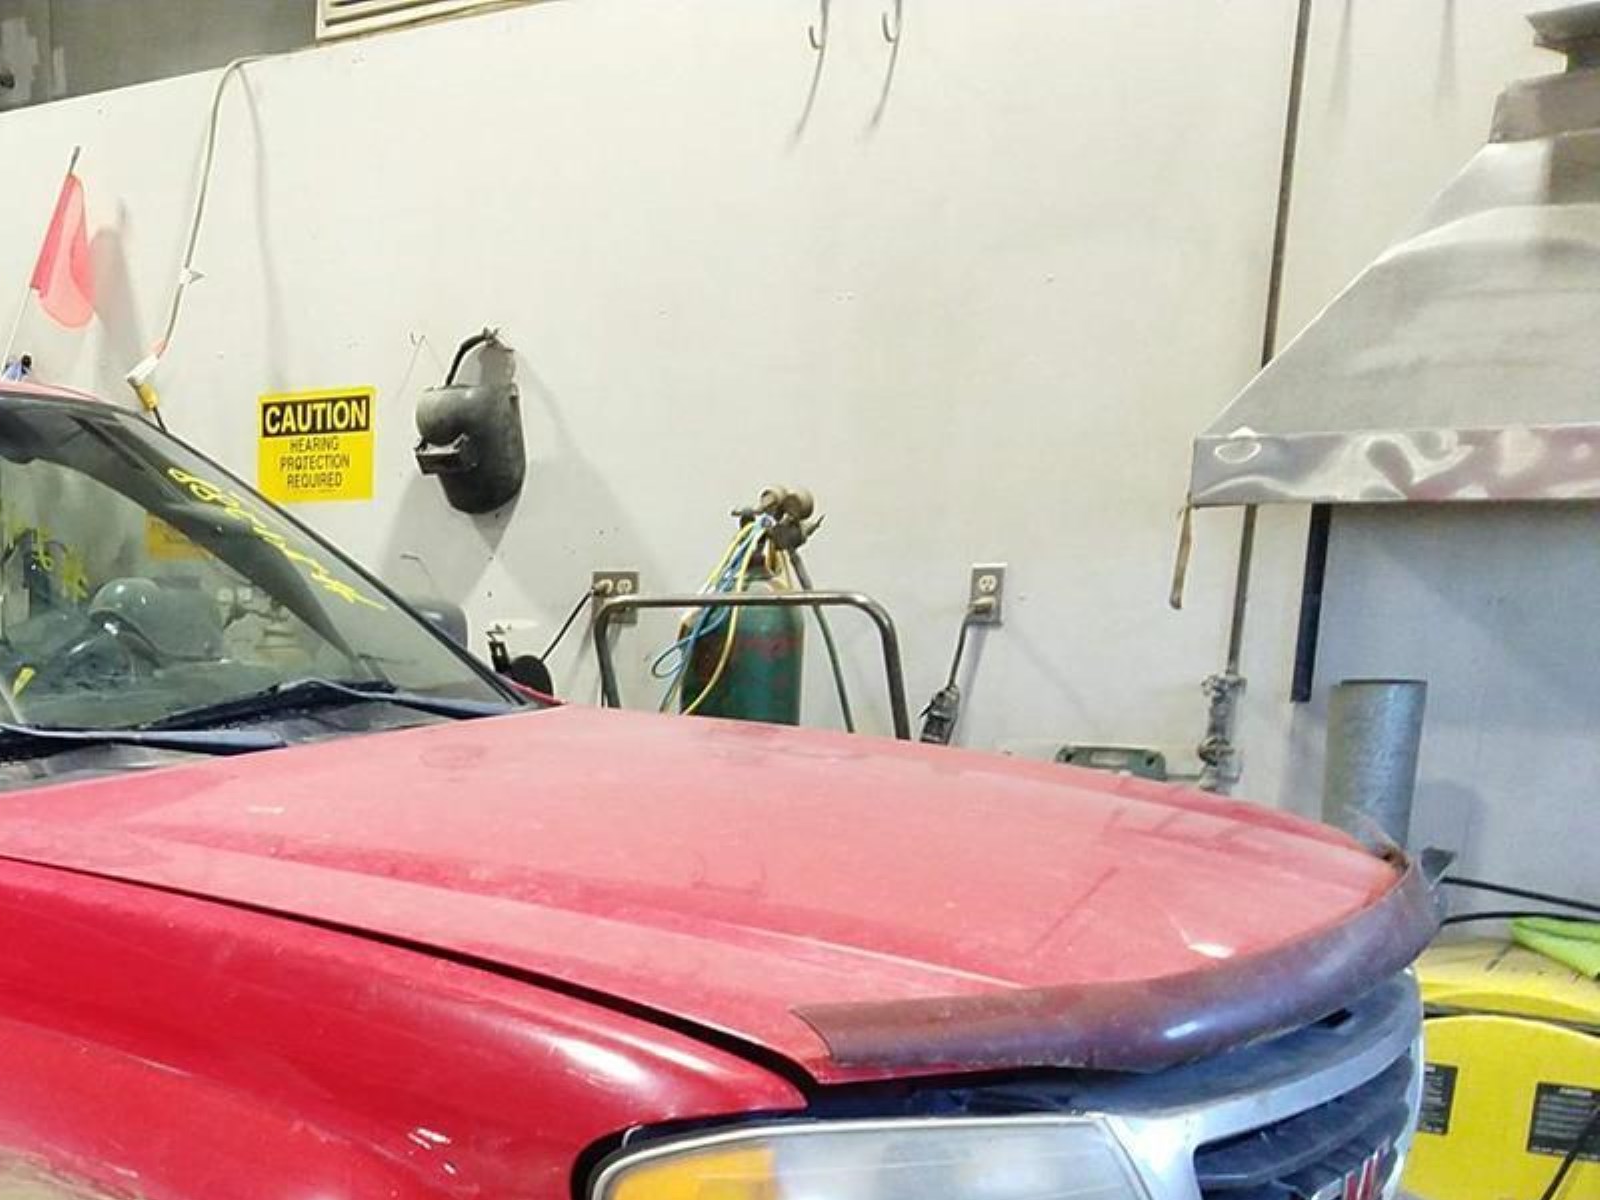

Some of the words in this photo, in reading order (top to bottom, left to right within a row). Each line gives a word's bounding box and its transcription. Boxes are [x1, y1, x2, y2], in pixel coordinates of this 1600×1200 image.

[264, 400, 368, 434] CAUTION
[289, 436, 340, 454] HEARING
[280, 454, 351, 472] PROTECTION
[287, 472, 343, 489] REQUIRED
